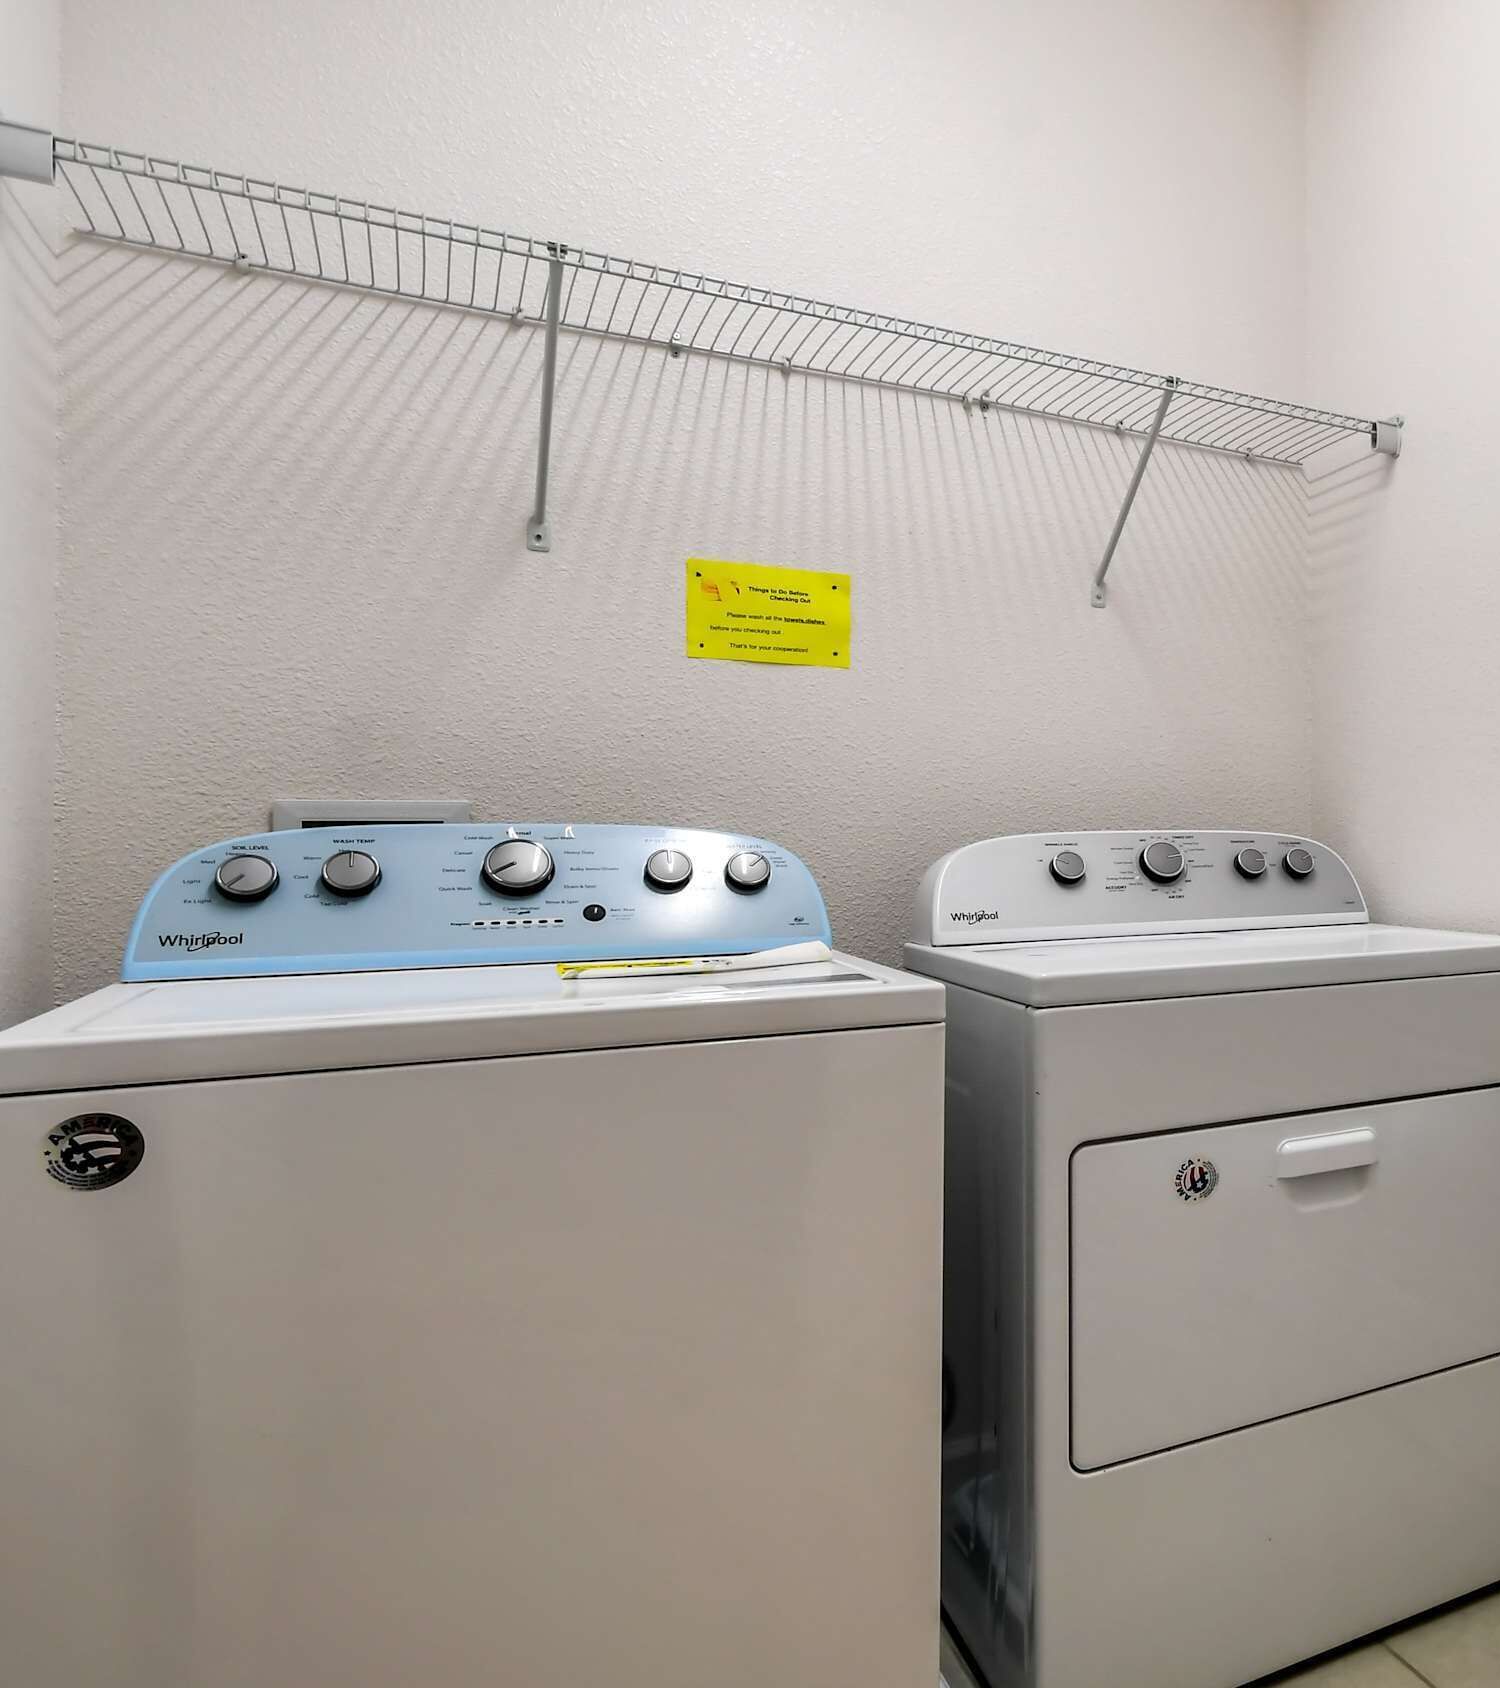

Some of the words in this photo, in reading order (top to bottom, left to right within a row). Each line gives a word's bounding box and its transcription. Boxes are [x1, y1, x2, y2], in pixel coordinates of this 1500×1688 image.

[748, 586, 770, 595] Things
[770, 594, 799, 604] Checking
[950, 910, 999, 926] Whirlpool
[158, 931, 243, 952] Whirlpool
[1174, 1159, 1194, 1201] AMERICA
